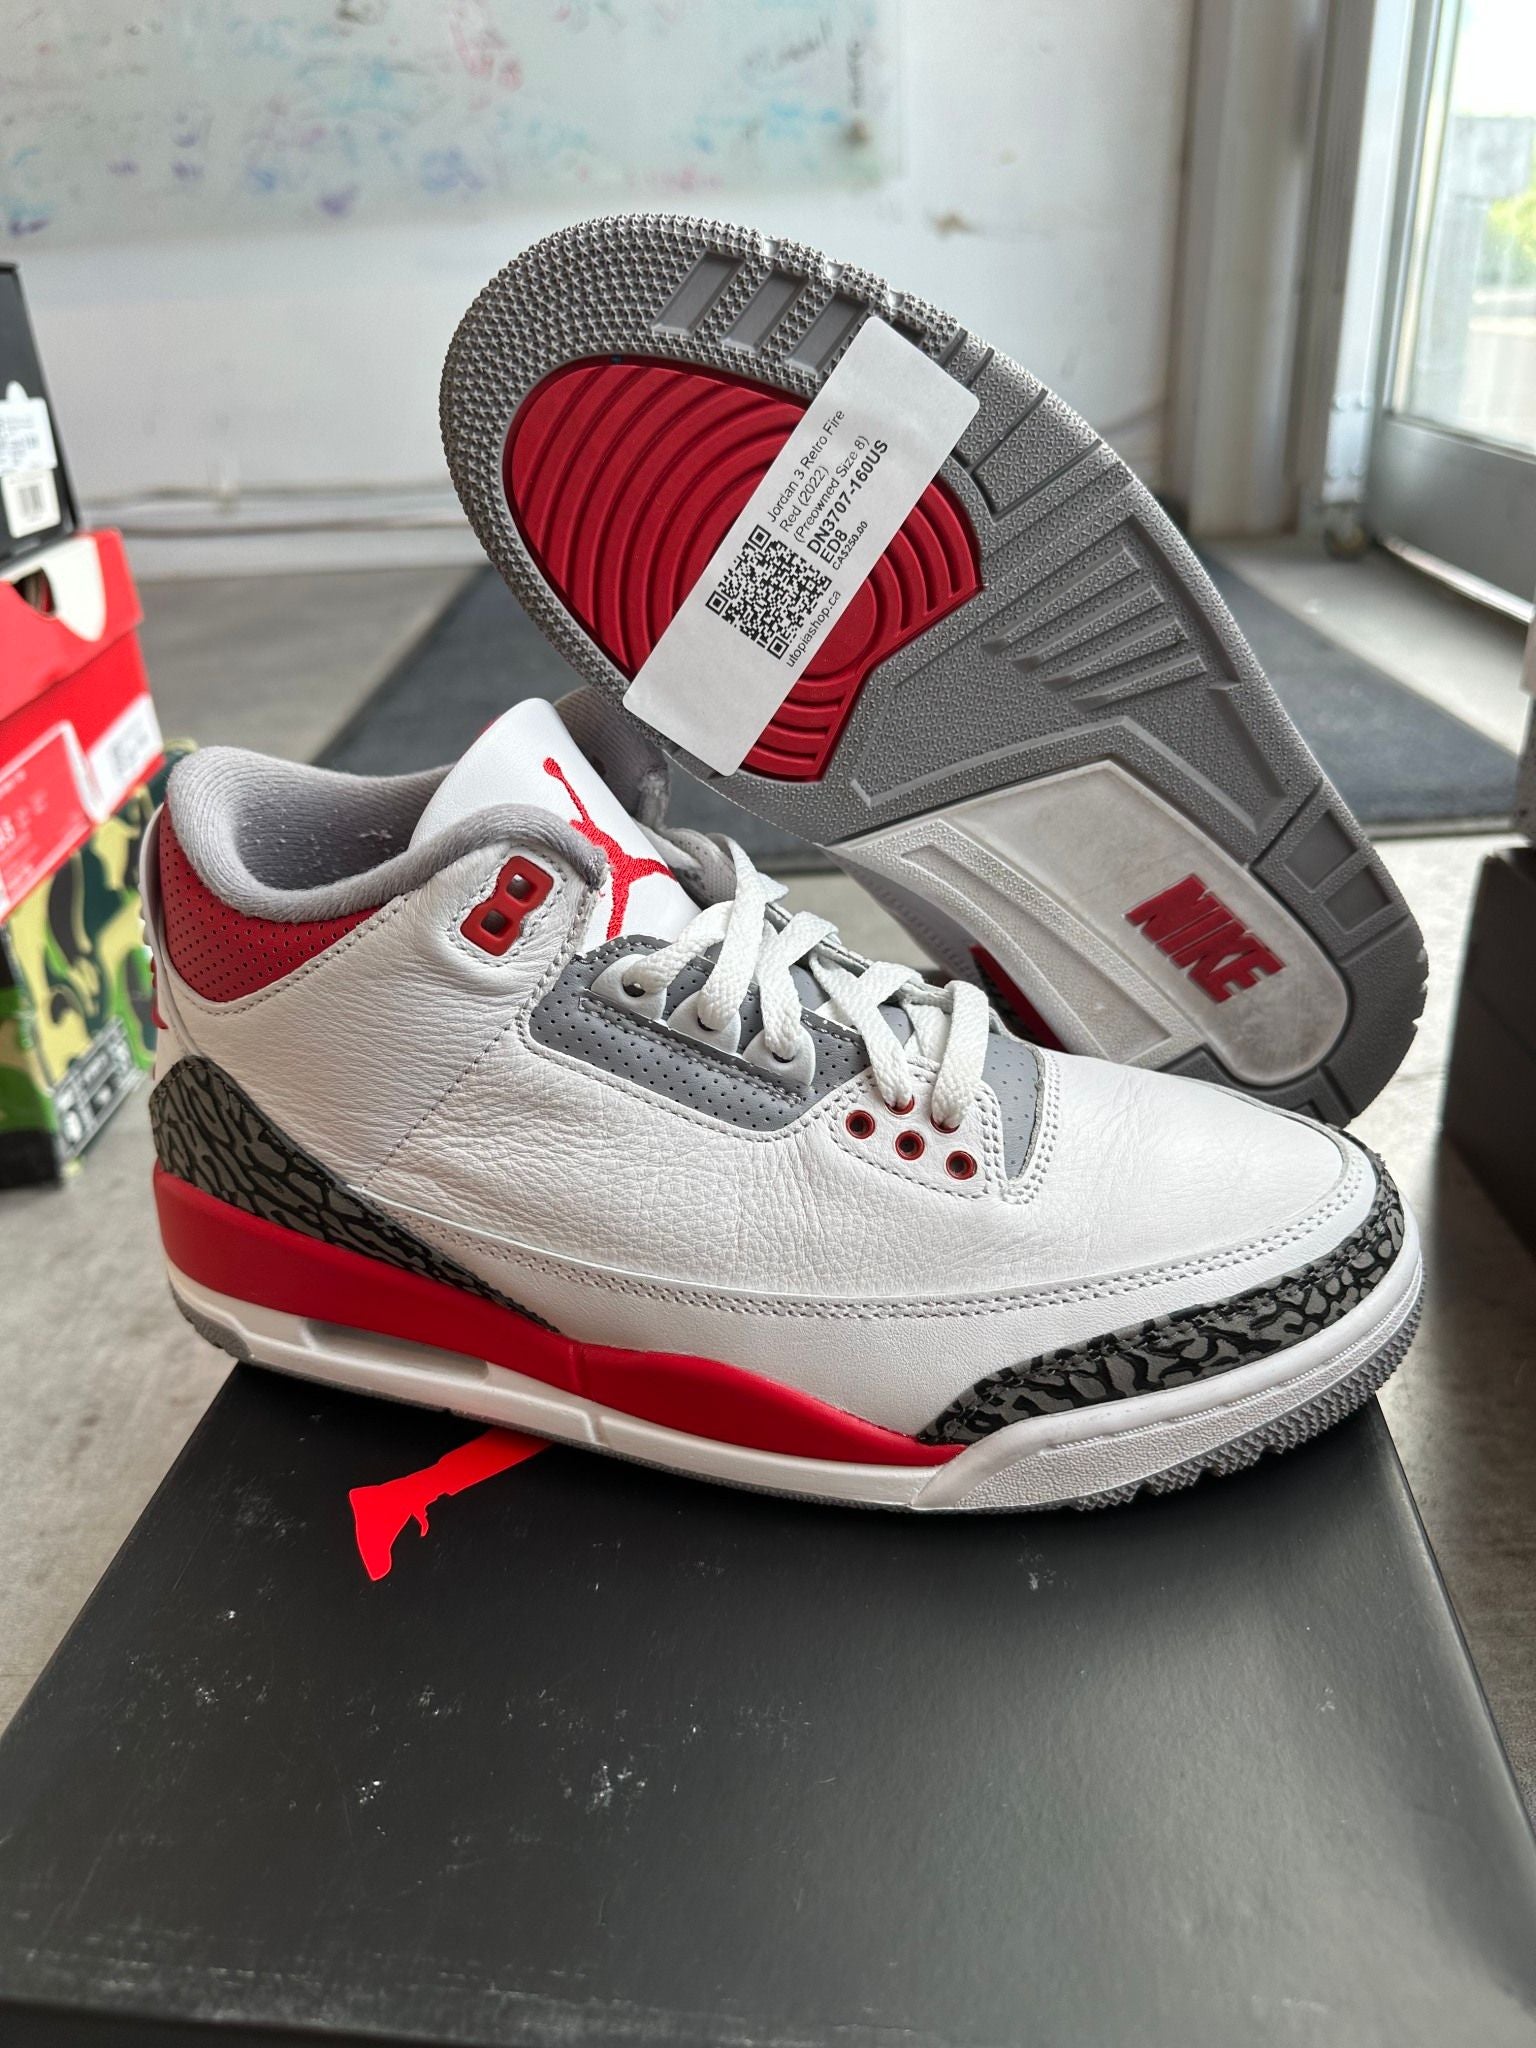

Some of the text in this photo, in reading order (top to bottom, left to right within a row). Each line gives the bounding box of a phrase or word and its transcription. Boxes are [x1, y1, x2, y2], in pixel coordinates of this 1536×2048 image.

[766, 409, 845, 523] Jordan 3 Retro Fire
[778, 464, 830, 533] Red (2022)
[792, 434, 870, 543] (Preowned Size 8)
[805, 438, 888, 555] DN3707-160US
[818, 528, 848, 565] ED8
[831, 519, 868, 571] CA$250.00
[785, 589, 841, 668] utopiashop.ca
[1124, 872, 1287, 1005] NIKE
